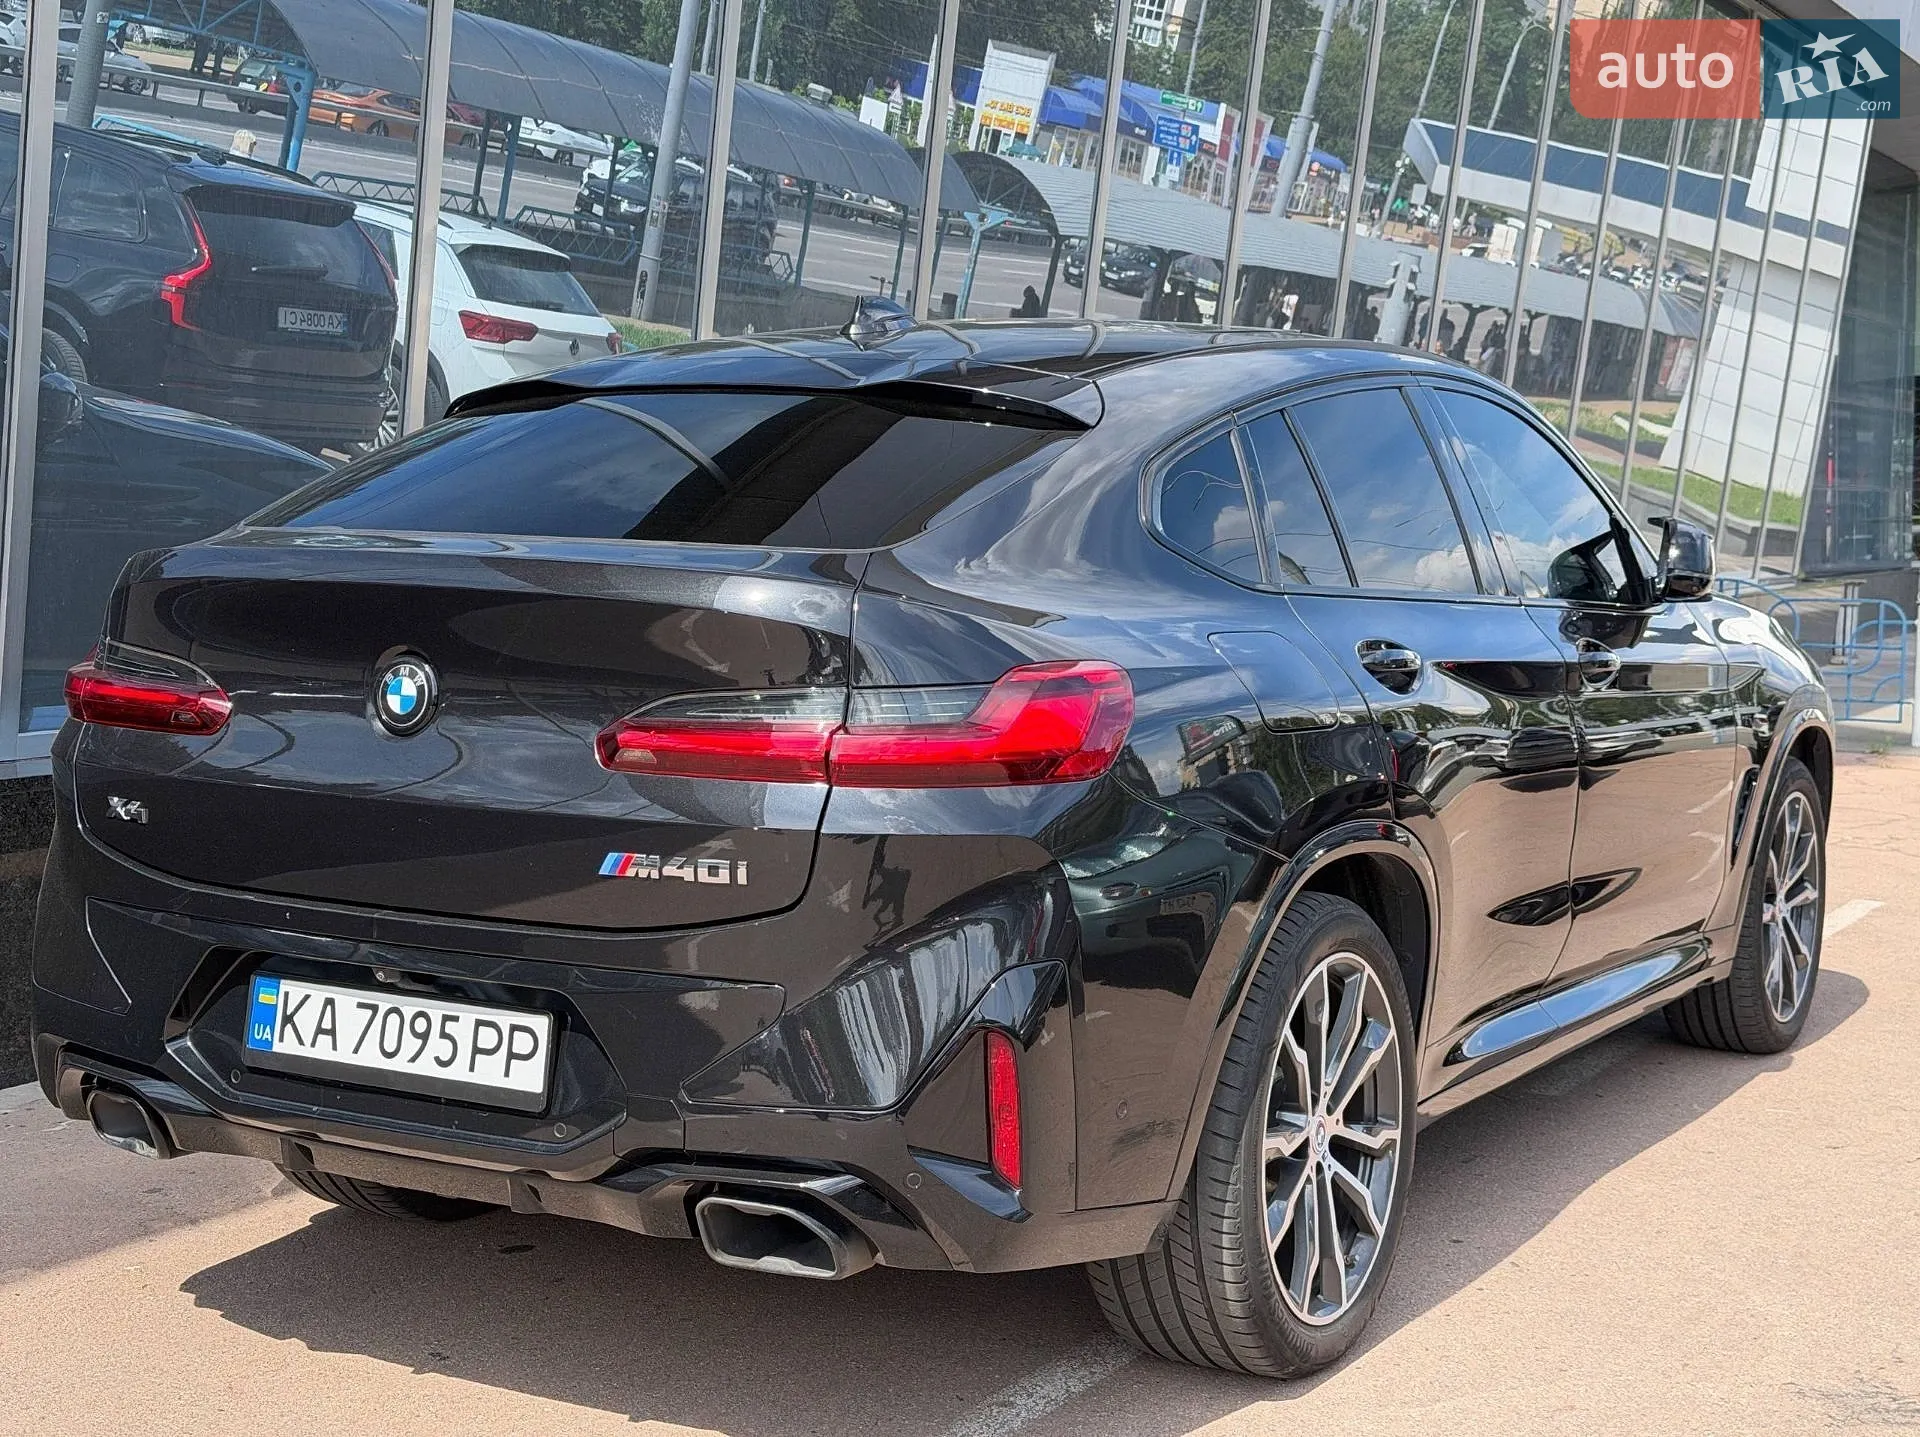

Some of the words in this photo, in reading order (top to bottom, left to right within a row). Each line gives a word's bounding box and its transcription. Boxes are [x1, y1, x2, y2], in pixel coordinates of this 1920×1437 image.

[386, 667, 424, 687] BMW
[106, 796, 149, 824] X4
[254, 1023, 272, 1041] UA
[278, 991, 338, 1052] KA
[352, 1001, 461, 1068] 7095
[468, 1018, 540, 1078] PP
